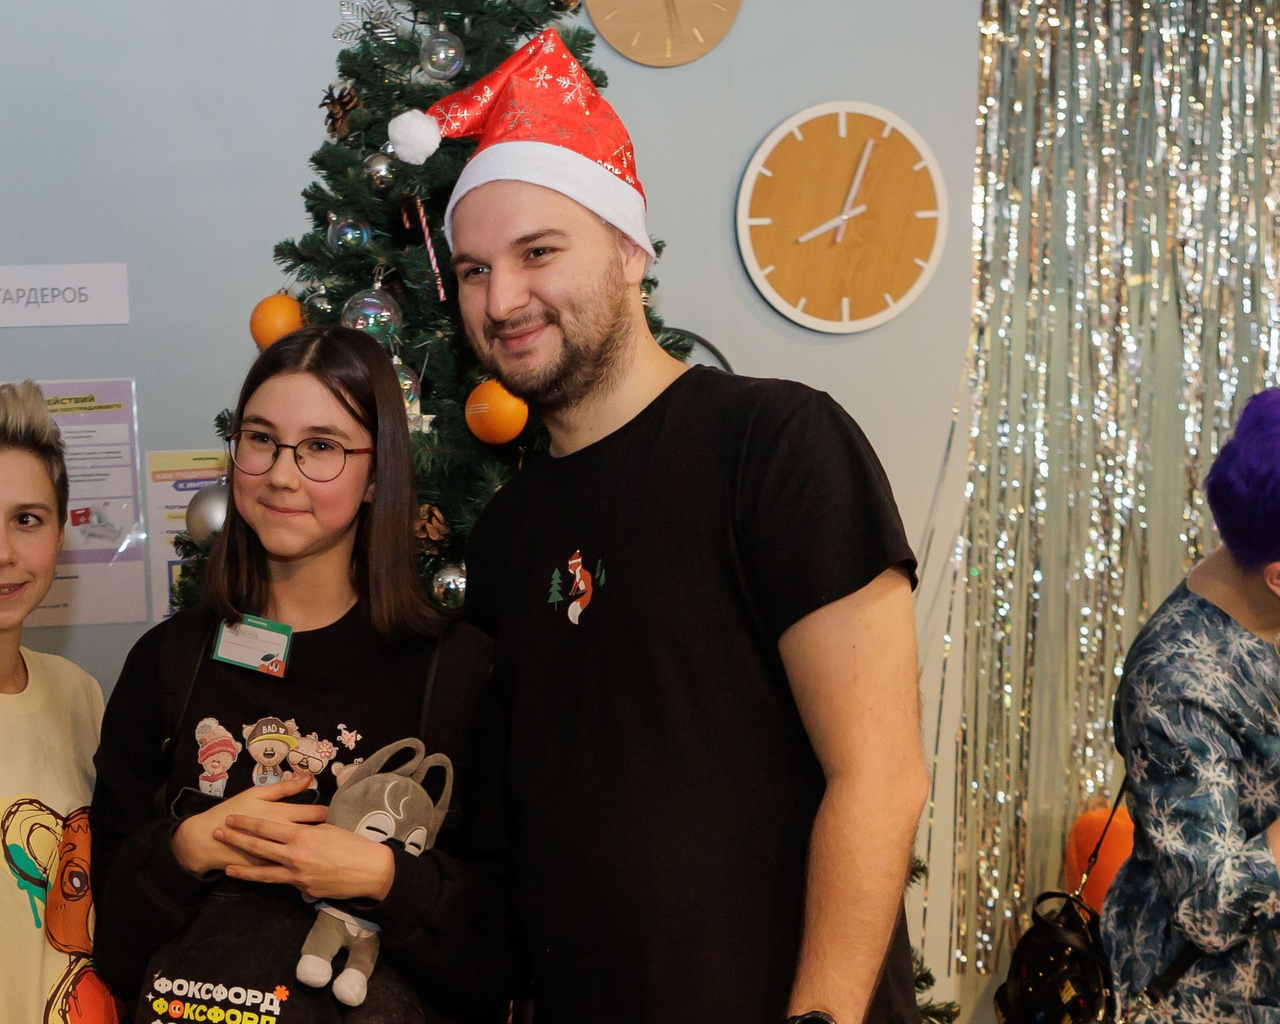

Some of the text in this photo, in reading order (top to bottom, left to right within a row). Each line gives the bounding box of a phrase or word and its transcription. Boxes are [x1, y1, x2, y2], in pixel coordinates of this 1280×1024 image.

[47, 394, 95, 406] ЕЙСТВИЙ
[262, 724, 278, 734] BAD
[153, 977, 281, 1016] ФОКСФОРД
